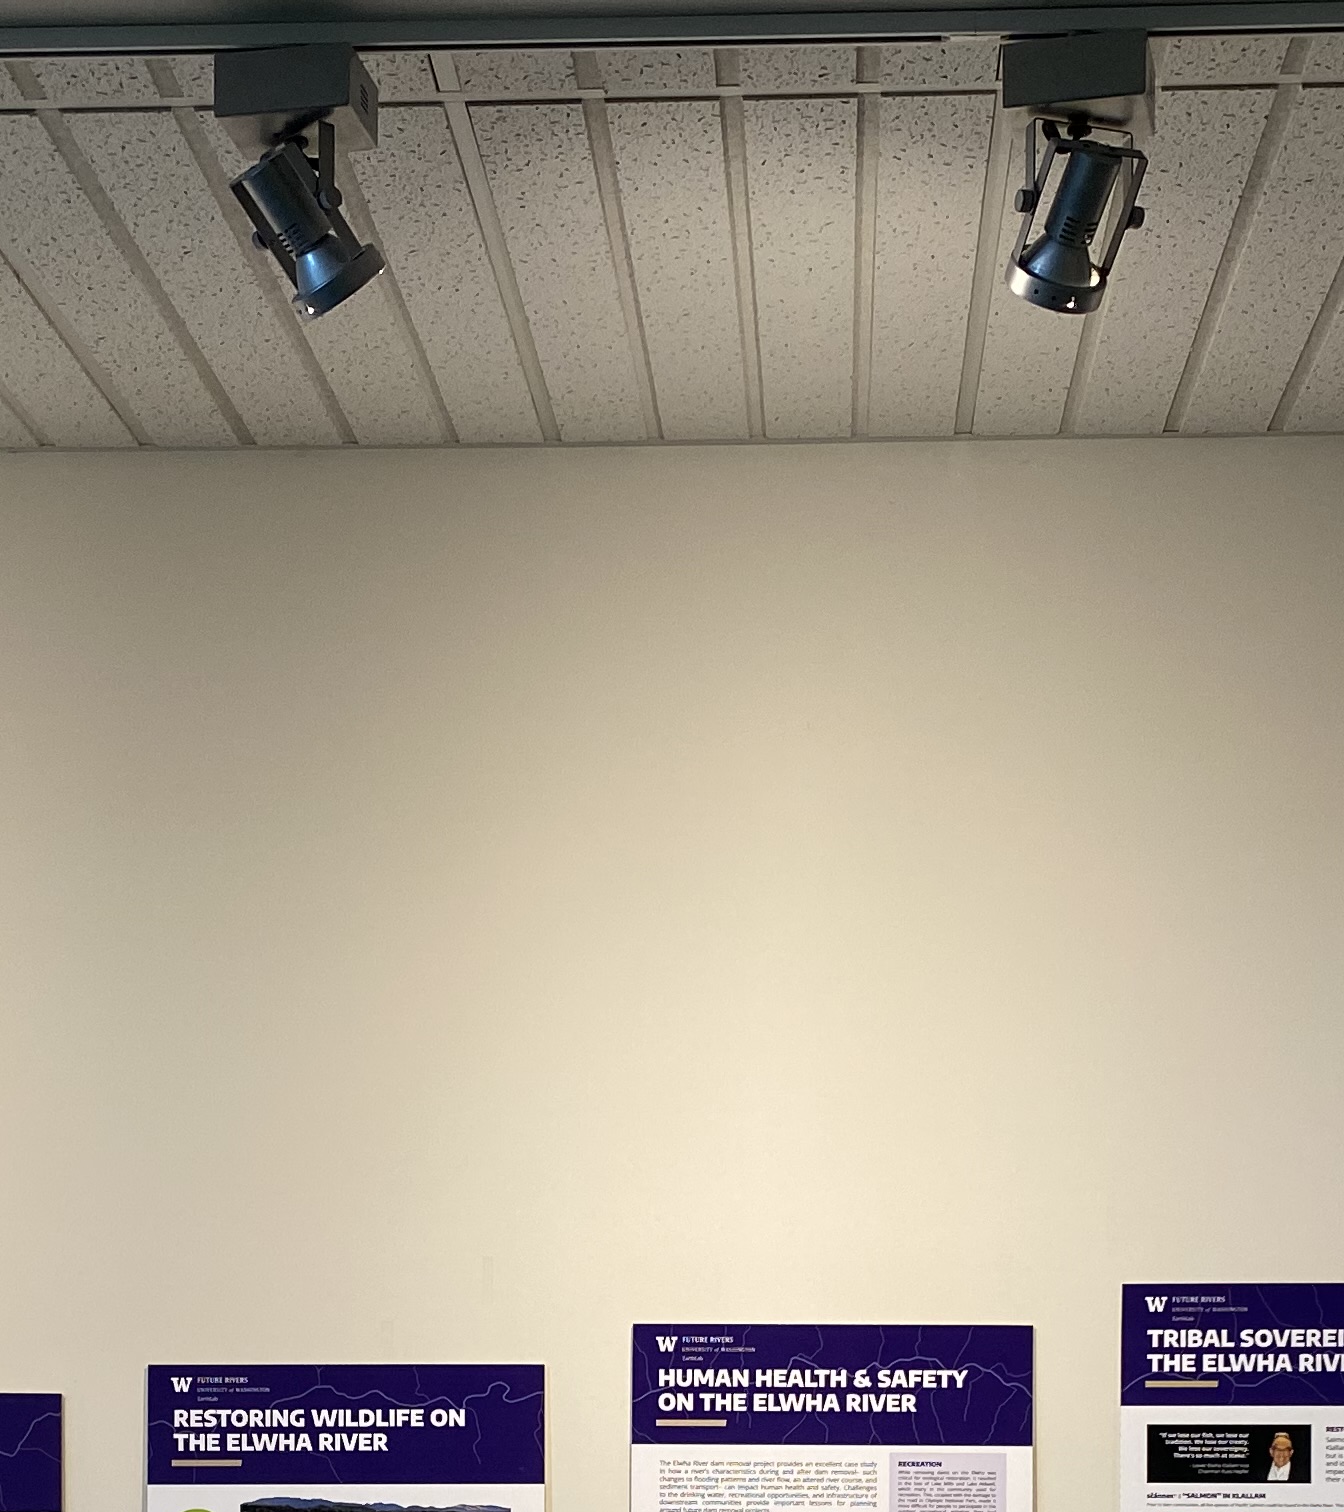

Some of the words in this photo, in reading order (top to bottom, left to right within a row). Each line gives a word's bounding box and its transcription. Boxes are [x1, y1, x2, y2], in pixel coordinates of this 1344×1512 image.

[1145, 1297, 1168, 1312] W
[1171, 1296, 1199, 1304] FUTURE
[1200, 1295, 1226, 1303] RIVERS
[656, 1336, 678, 1352] W
[682, 1336, 708, 1344] FUTURE
[709, 1336, 734, 1344] RIVERS
[1147, 1329, 1235, 1347] TRIBAL
[1147, 1354, 1196, 1372] THE
[1203, 1354, 1292, 1372] ELWHA
[171, 1377, 192, 1392] W
[197, 1376, 223, 1384] FUTURE
[224, 1376, 249, 1384] RIVERS
[659, 1369, 749, 1387] HUMAN
[756, 1369, 847, 1387] HEALTH
[853, 1369, 872, 1388] &
[878, 1370, 968, 1388] SAFETY
[658, 1393, 693, 1411] ON
[699, 1393, 747, 1411] THE
[753, 1393, 840, 1412] ELWHA
[846, 1394, 916, 1412] RIVER
[174, 1409, 305, 1427] RESTORING
[311, 1409, 424, 1427] WILDLIFE
[430, 1409, 465, 1427] ON
[173, 1433, 220, 1451] THE
[227, 1433, 312, 1451] ELWHA
[319, 1433, 388, 1451] RIVER
[897, 1460, 943, 1468] RECREATION
